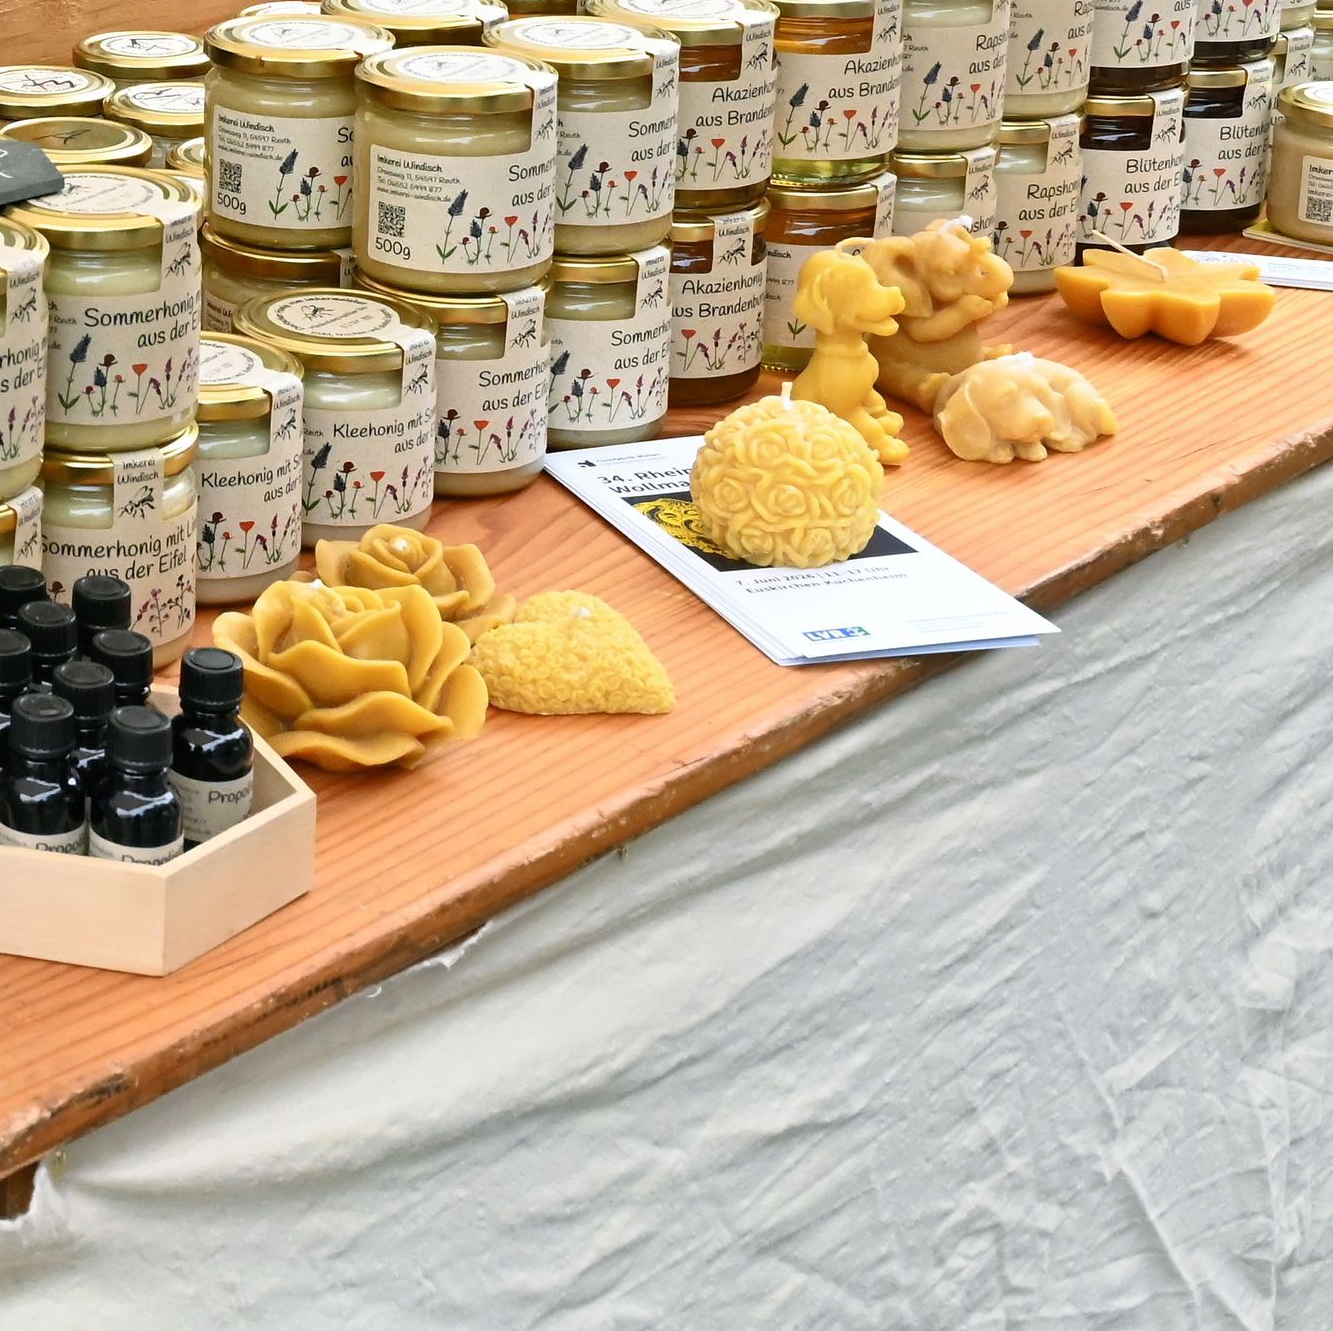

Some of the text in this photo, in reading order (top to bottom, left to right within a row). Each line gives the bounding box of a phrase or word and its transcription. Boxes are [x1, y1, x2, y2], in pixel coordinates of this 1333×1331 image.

[1068, 24, 1085, 40] aus
[969, 59, 992, 75] aus
[828, 85, 857, 100] aus
[240, 120, 274, 133] Windisch
[695, 111, 724, 128] aus
[632, 140, 671, 162] aus der
[1218, 144, 1262, 160] aus der
[403, 160, 442, 172] Windisch
[512, 181, 550, 207] aus der
[1124, 176, 1173, 195] aus der
[217, 193, 247, 216] 500g
[1018, 202, 1067, 220] aus der
[375, 238, 411, 261] 500g
[681, 268, 763, 295] Akazienhonig
[137, 321, 189, 349] aus der
[614, 347, 660, 370] aus der
[13, 367, 36, 389] der
[482, 390, 533, 411] aus der
[332, 409, 430, 442] Kleehonig mit
[393, 436, 417, 456] aus
[201, 458, 294, 491] Kleehonig mit
[597, 475, 633, 484] 34.
[263, 485, 285, 504] aus
[609, 480, 689, 494] Wollma
[41, 524, 185, 558] Sommerhonig mit
[125, 545, 187, 580] der Eifel
